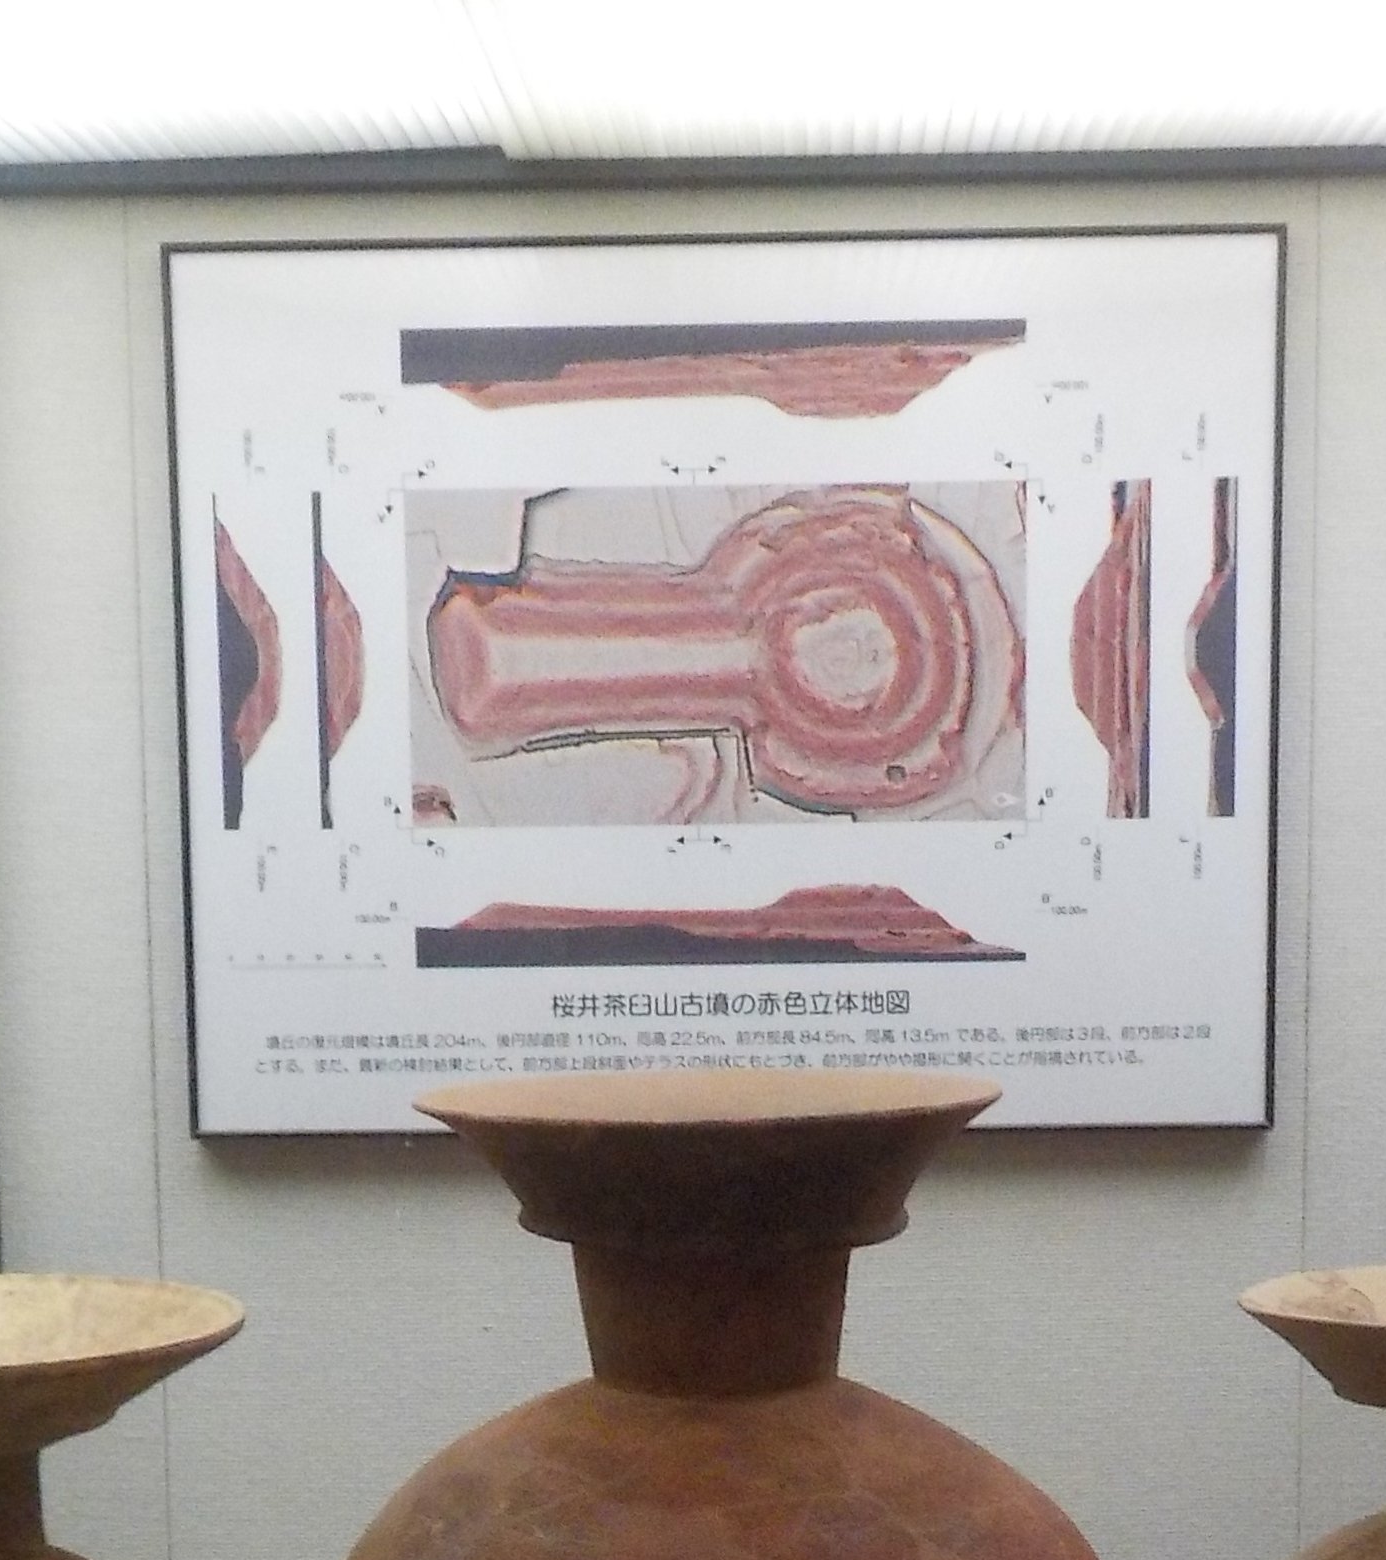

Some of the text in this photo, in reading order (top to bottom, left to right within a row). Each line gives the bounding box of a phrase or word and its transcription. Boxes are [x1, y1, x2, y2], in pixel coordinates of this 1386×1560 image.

[551, 990, 911, 1018] 桜井茶臼山古墳の赤色立体地図
